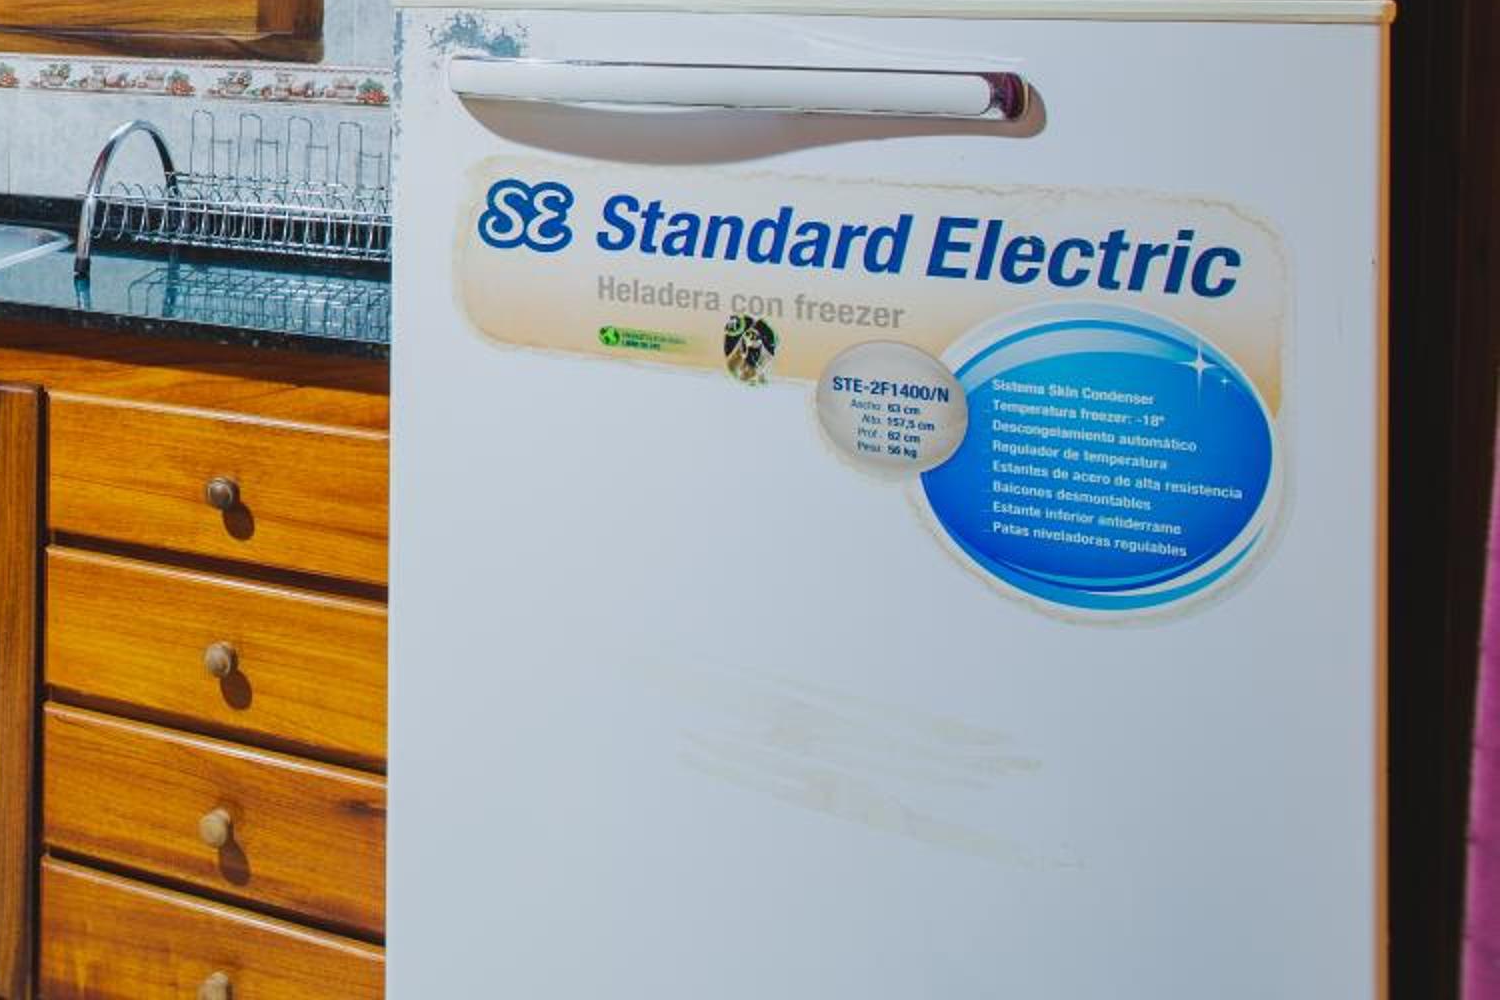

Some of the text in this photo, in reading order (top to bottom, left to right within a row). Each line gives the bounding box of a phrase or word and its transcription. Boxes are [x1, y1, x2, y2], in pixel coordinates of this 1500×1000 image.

[597, 194, 1242, 298] Standard Electric
[597, 275, 904, 328] Heladera con freezer
[832, 375, 949, 403] STE-2F1400/N
[993, 379, 1155, 405] Sistema Skin Condenser
[887, 402, 901, 413] 63
[903, 405, 921, 415] cm
[993, 399, 1077, 419] Temperatura
[1080, 406, 1132, 424] freezer:
[887, 417, 916, 430] 157,5
[917, 421, 935, 431] cm
[887, 431, 901, 442] 62
[903, 434, 921, 443] cm
[993, 420, 1197, 452] Descongelamiento automático
[903, 447, 918, 459] kg
[993, 440, 1168, 470] Regulador de temperatura
[993, 460, 1243, 500] Estantes de acero de alta resistencia
[993, 480, 1152, 511] Balcones desmontables
[993, 501, 1182, 535] Estante inferior antiderrame
[993, 521, 1187, 557] Patas niveladoras regulables
